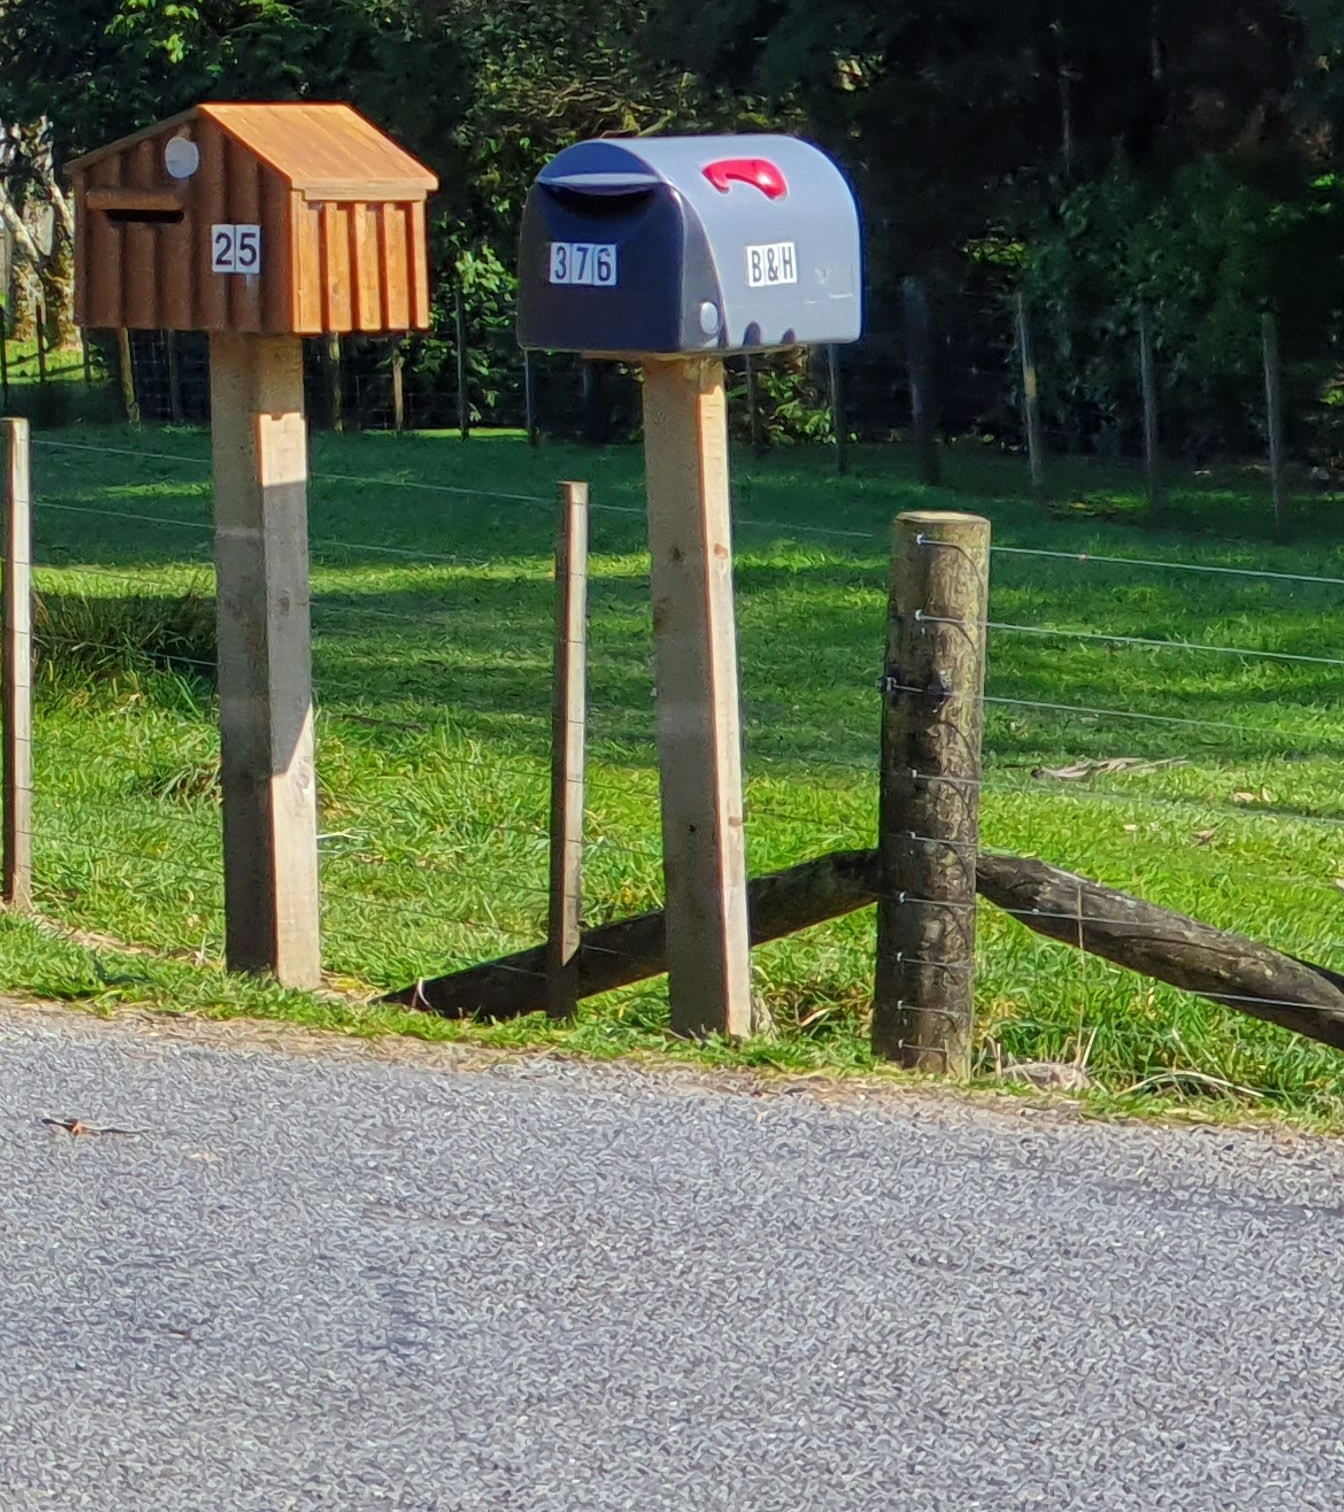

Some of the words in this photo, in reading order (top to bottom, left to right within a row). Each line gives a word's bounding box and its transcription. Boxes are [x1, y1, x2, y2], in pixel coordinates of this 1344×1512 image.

[215, 232, 257, 267] 25
[555, 246, 611, 282] 376
[751, 247, 793, 283] B&H
